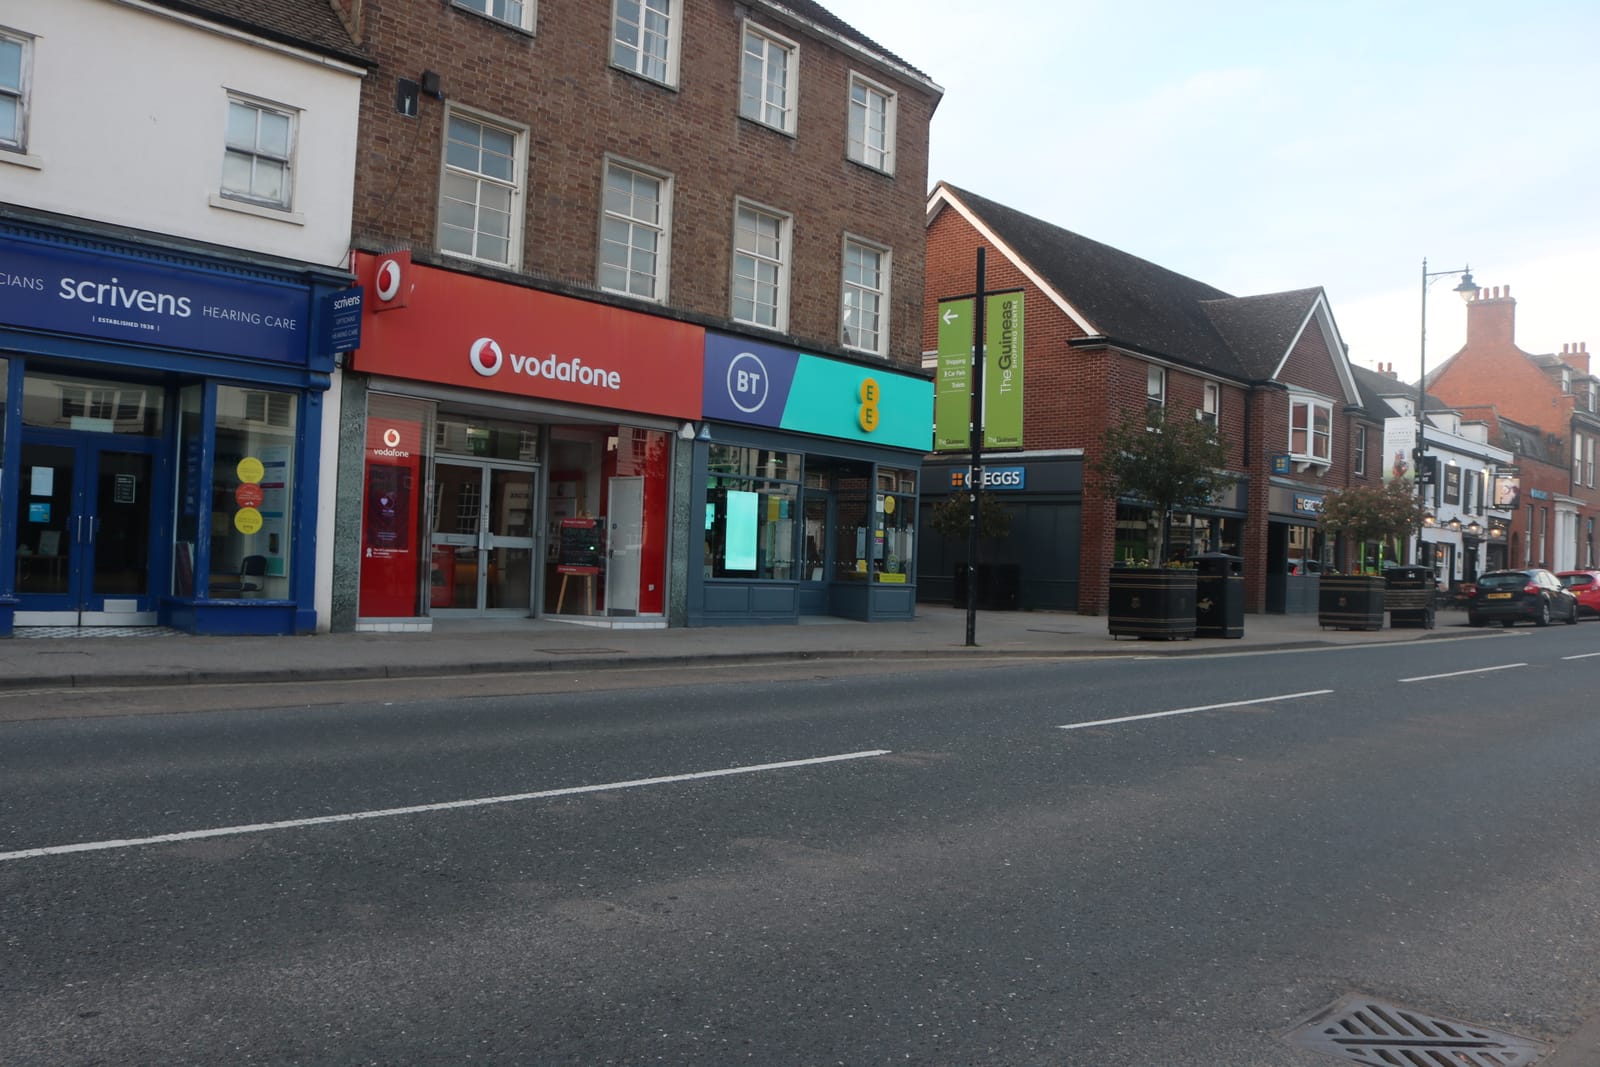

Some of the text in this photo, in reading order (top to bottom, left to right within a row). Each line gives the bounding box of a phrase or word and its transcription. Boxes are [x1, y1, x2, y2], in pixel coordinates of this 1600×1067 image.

[59, 277, 192, 318] scrivens
[334, 296, 360, 310] scrivens
[98, 316, 139, 329] ESTABLISHED
[203, 305, 296, 330] HEARING CARE
[998, 301, 1012, 395] The Guineas
[510, 354, 620, 390] vodafone
[737, 370, 760, 395] BT
[373, 449, 409, 458] vodafone
[965, 471, 1020, 486] EGGS
